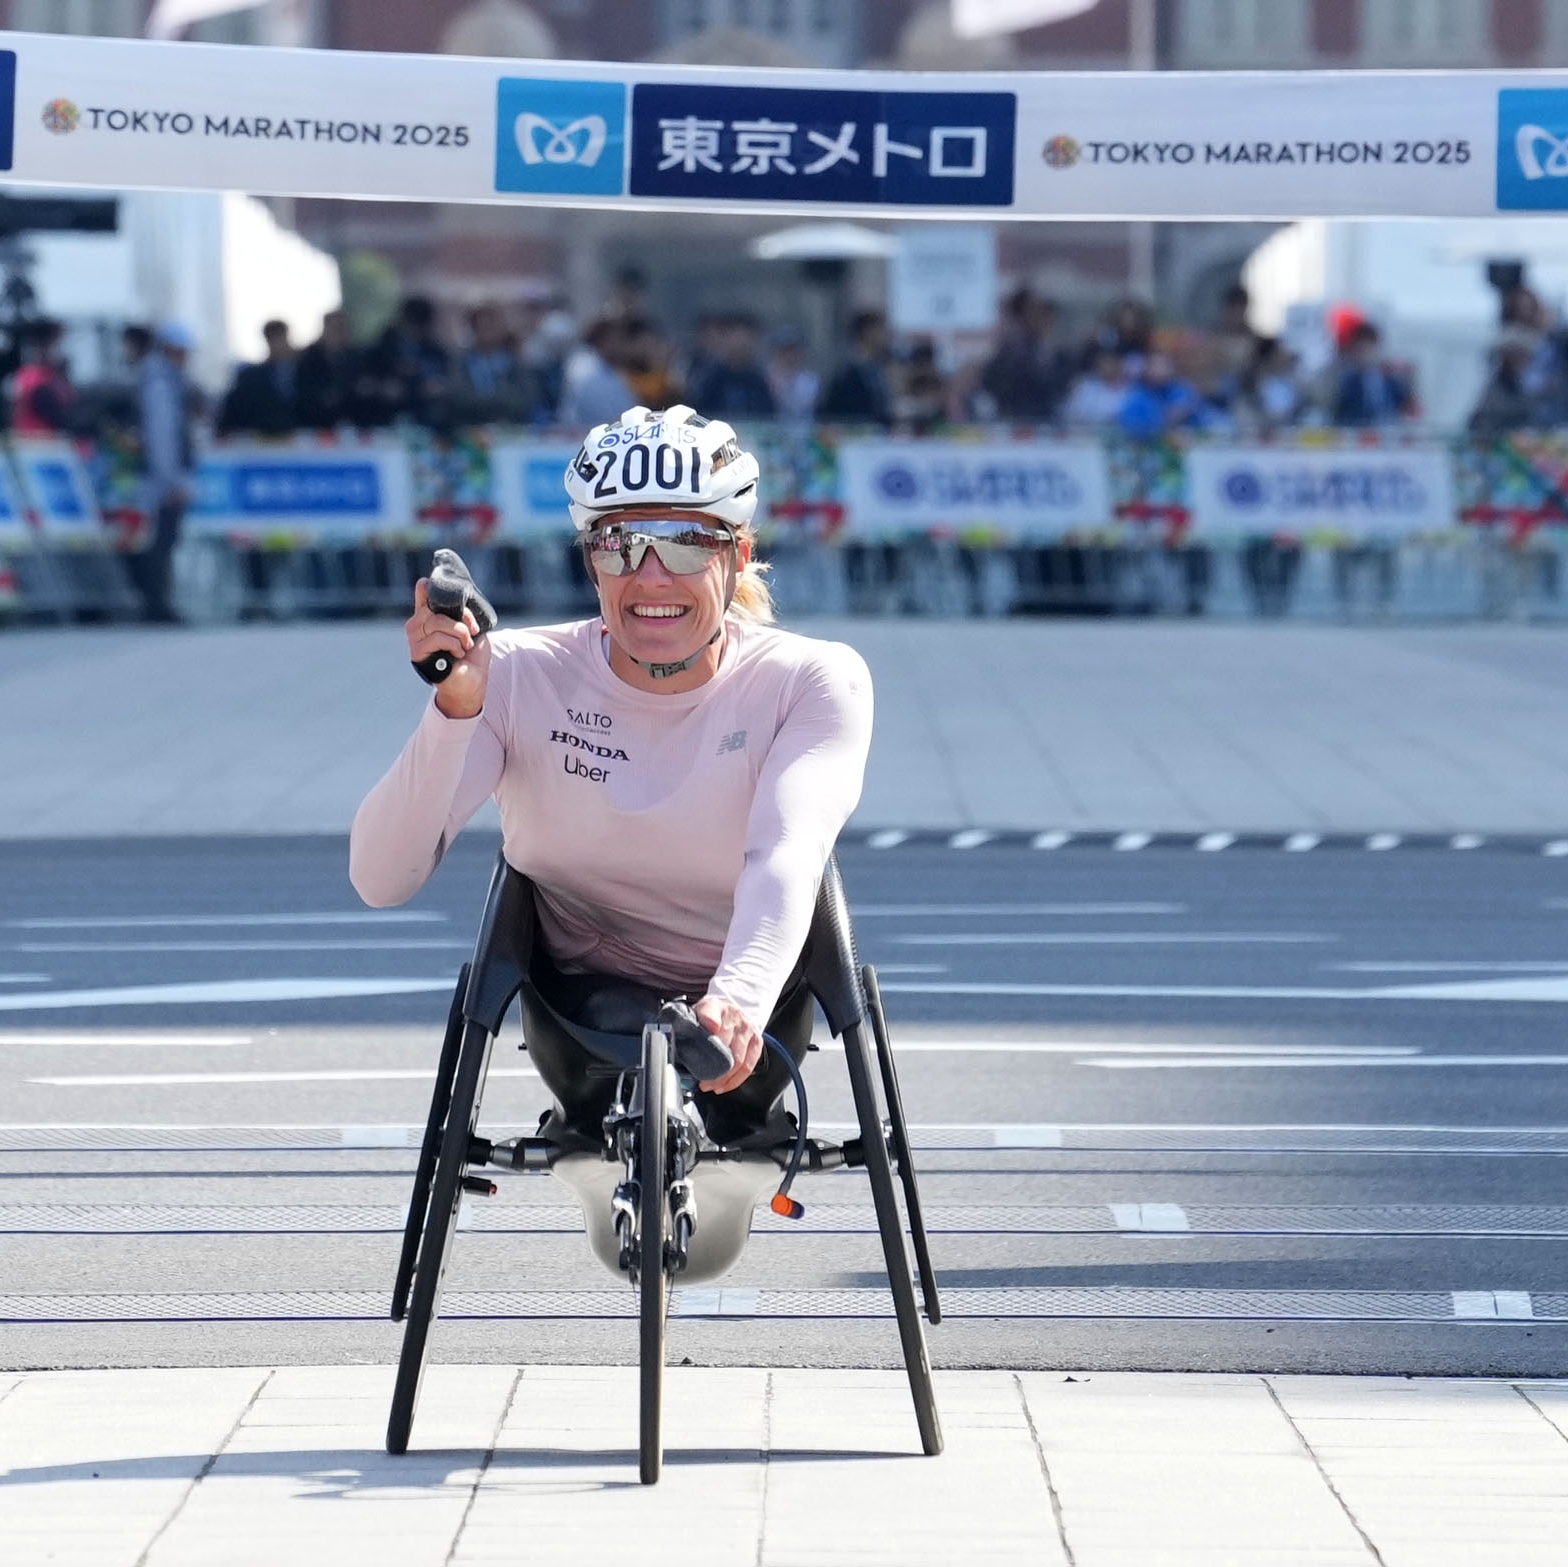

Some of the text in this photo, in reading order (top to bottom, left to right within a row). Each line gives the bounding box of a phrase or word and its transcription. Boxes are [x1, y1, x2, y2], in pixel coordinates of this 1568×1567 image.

[87, 108, 470, 147] TOKYO MARATHON 2025
[656, 115, 987, 178] 東京メトロ
[1087, 140, 1471, 164] TOKYO MARATHON 2025
[594, 443, 701, 499] 2001
[566, 709, 612, 728] SALTO
[549, 730, 631, 762] HONDA
[564, 754, 611, 783] Uber
